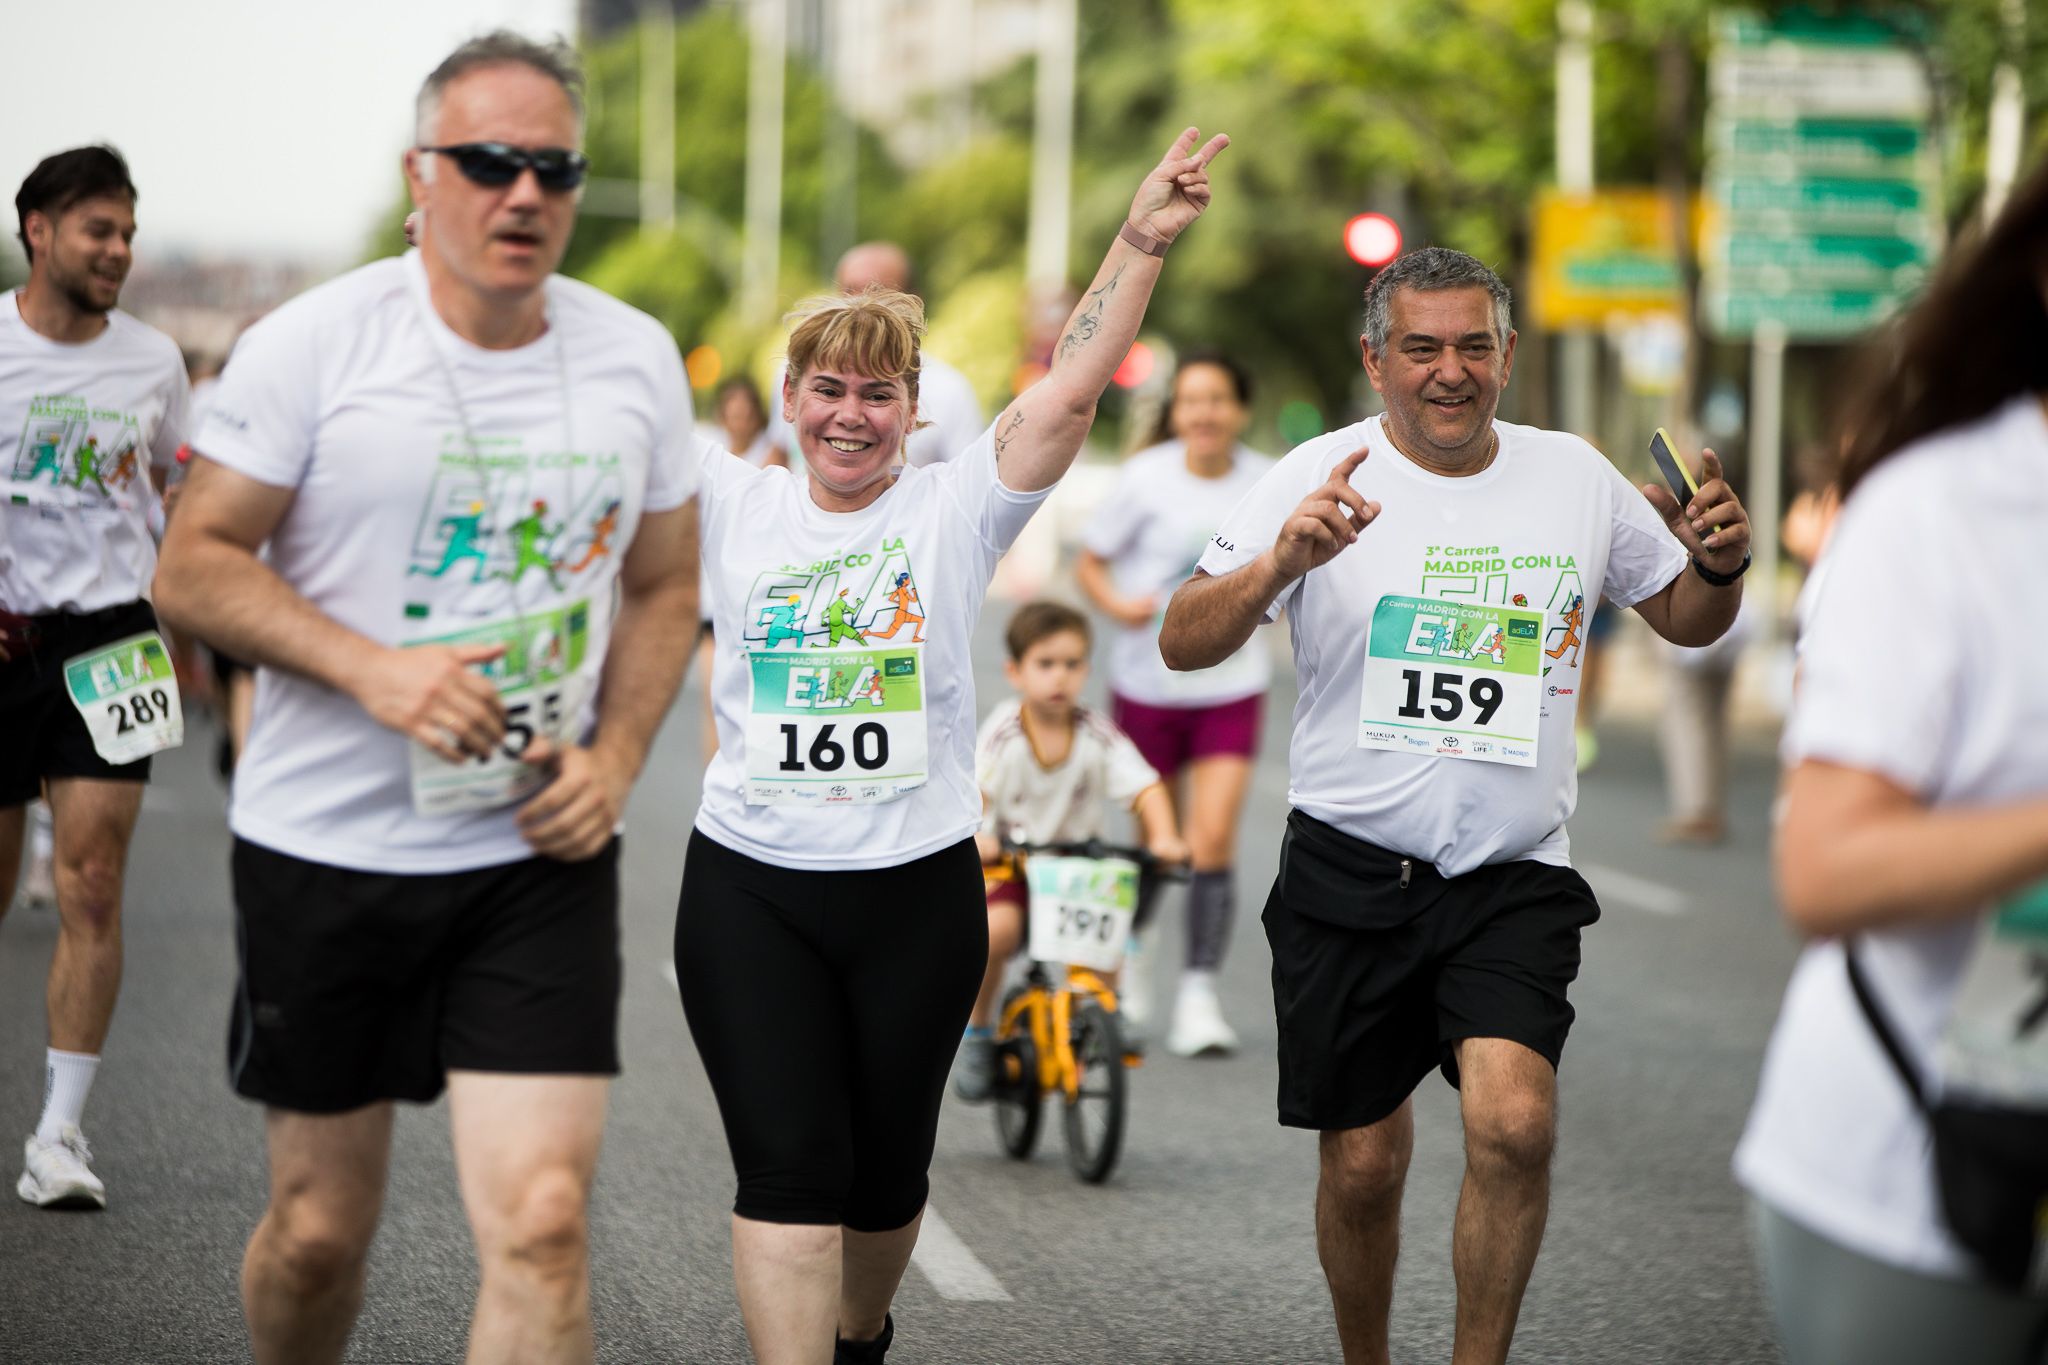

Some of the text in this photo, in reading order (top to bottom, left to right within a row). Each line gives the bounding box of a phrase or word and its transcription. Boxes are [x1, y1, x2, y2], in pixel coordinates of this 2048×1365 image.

[882, 537, 906, 552] LA
[1444, 545, 1500, 557] Carrera
[1424, 555, 1577, 574] MADRID CON LA
[1389, 600, 1415, 609] Carrera
[1417, 603, 1459, 616] MADRID
[1461, 609, 1484, 620] CON
[1486, 611, 1500, 622] LA
[1404, 613, 1505, 664] ELA
[789, 656, 831, 666] MADRID
[833, 656, 858, 666] CON
[859, 655, 874, 664] LA
[90, 648, 155, 699] ELA
[785, 666, 885, 709] ELA
[1398, 669, 1504, 726] 159
[107, 688, 168, 736] 289
[1366, 731, 1396, 739] MUKUA
[779, 721, 889, 772] 160
[1507, 749, 1530, 758] MADRID
